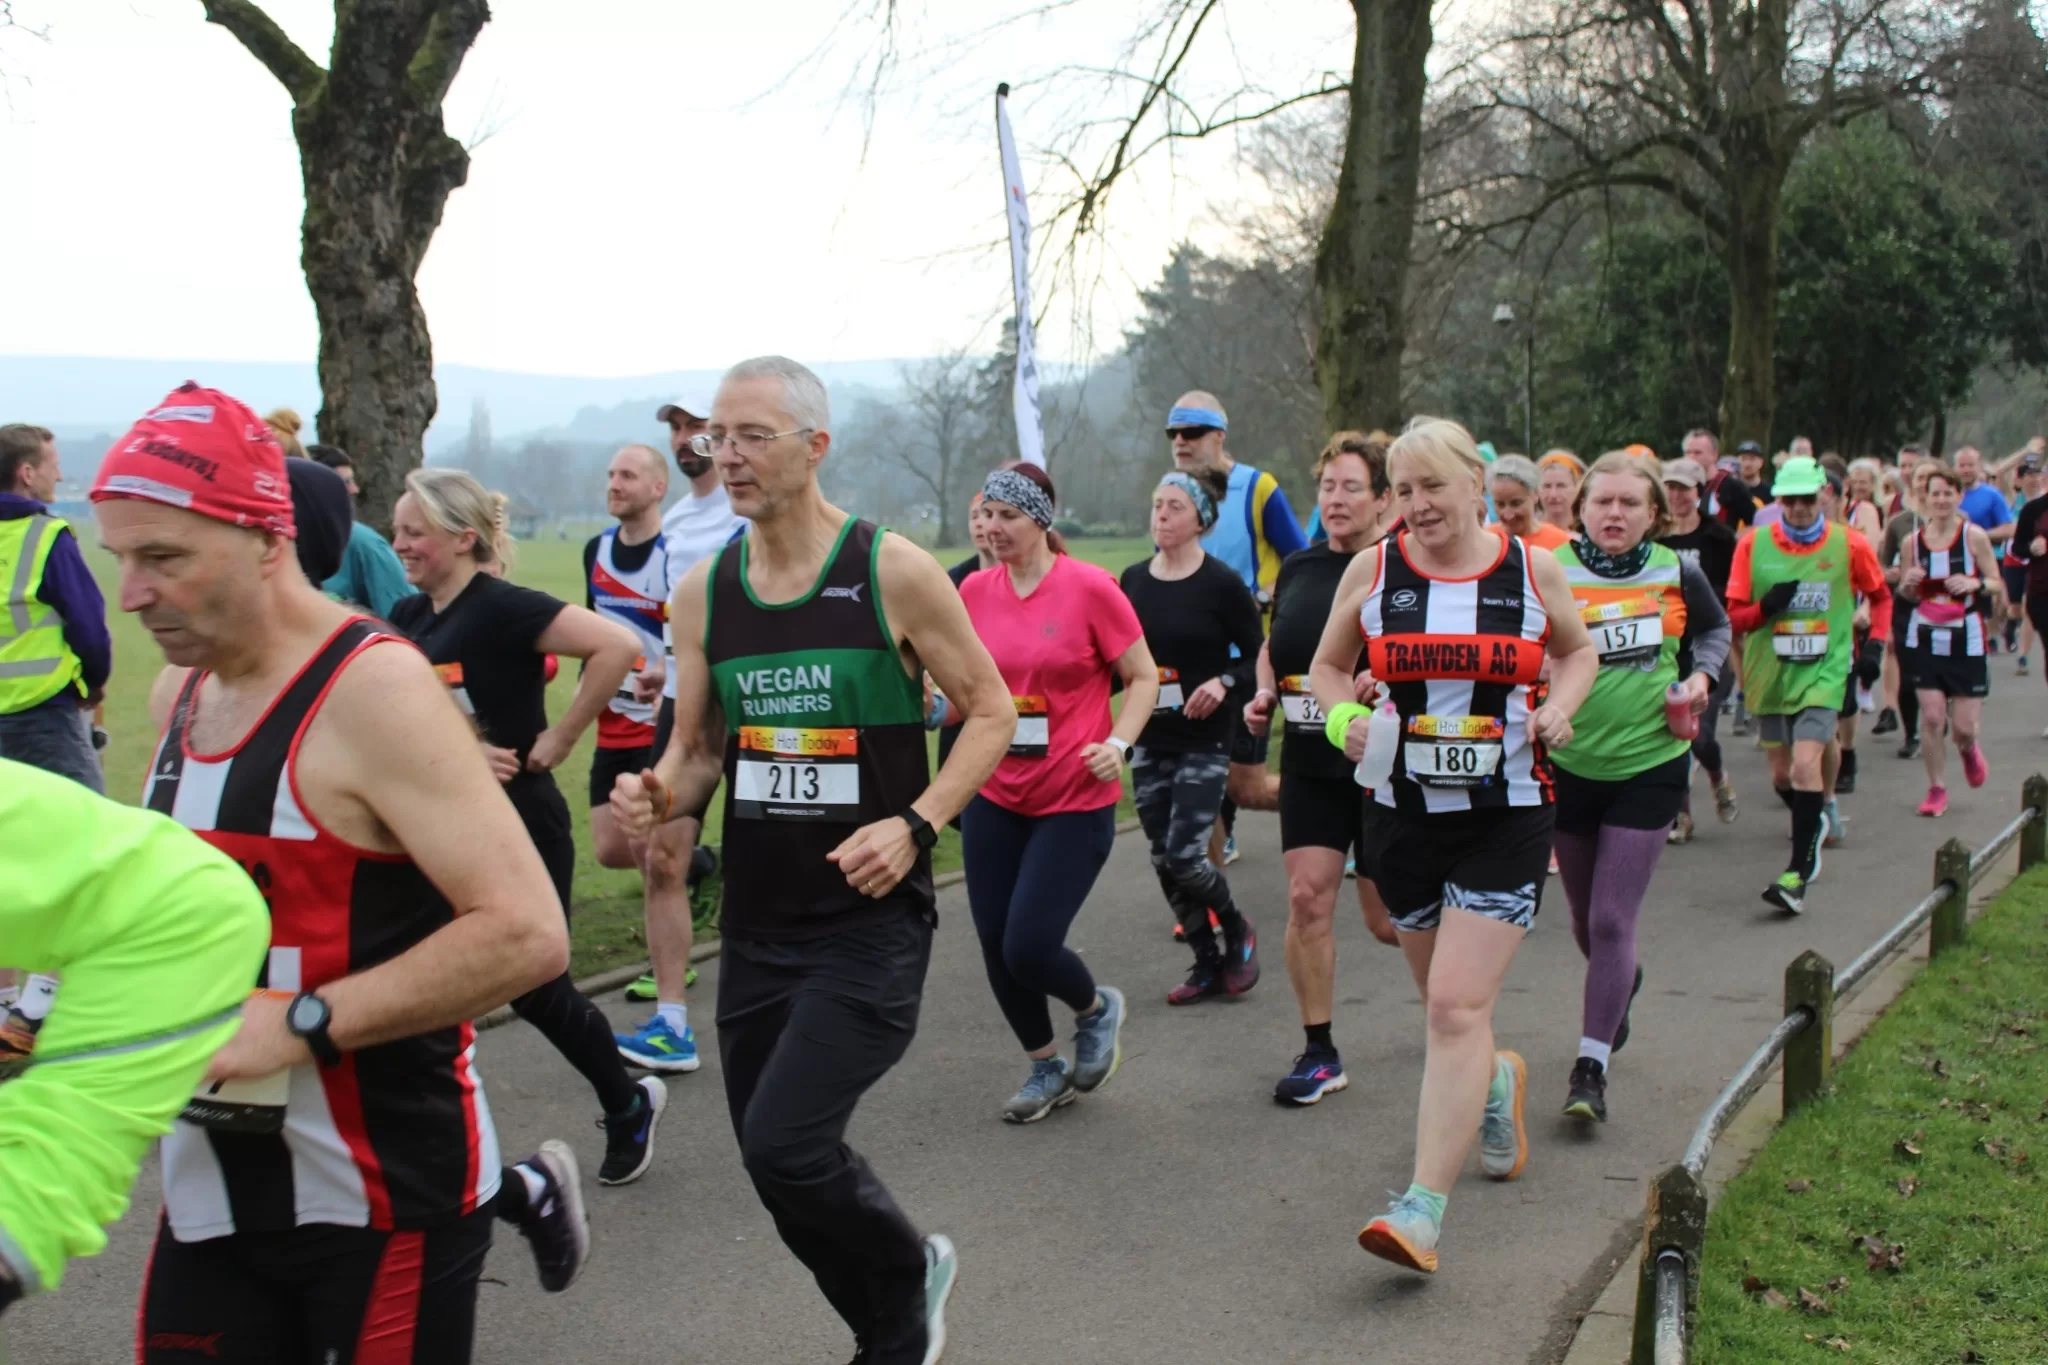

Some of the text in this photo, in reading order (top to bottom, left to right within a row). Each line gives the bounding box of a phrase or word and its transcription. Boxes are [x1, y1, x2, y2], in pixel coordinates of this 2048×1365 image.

[1482, 597, 1520, 608] Team TAC
[1603, 622, 1639, 651] 157
[1791, 638, 1813, 654] 101
[1385, 641, 1518, 676] TRAWDEN AC
[736, 664, 832, 696] VEGAN
[741, 693, 833, 717] RUNNERS
[1418, 721, 1493, 735] Red Hot Toddy
[754, 732, 840, 752] Red Hot Toddy
[1434, 746, 1478, 774] 180
[769, 764, 820, 801] 213
